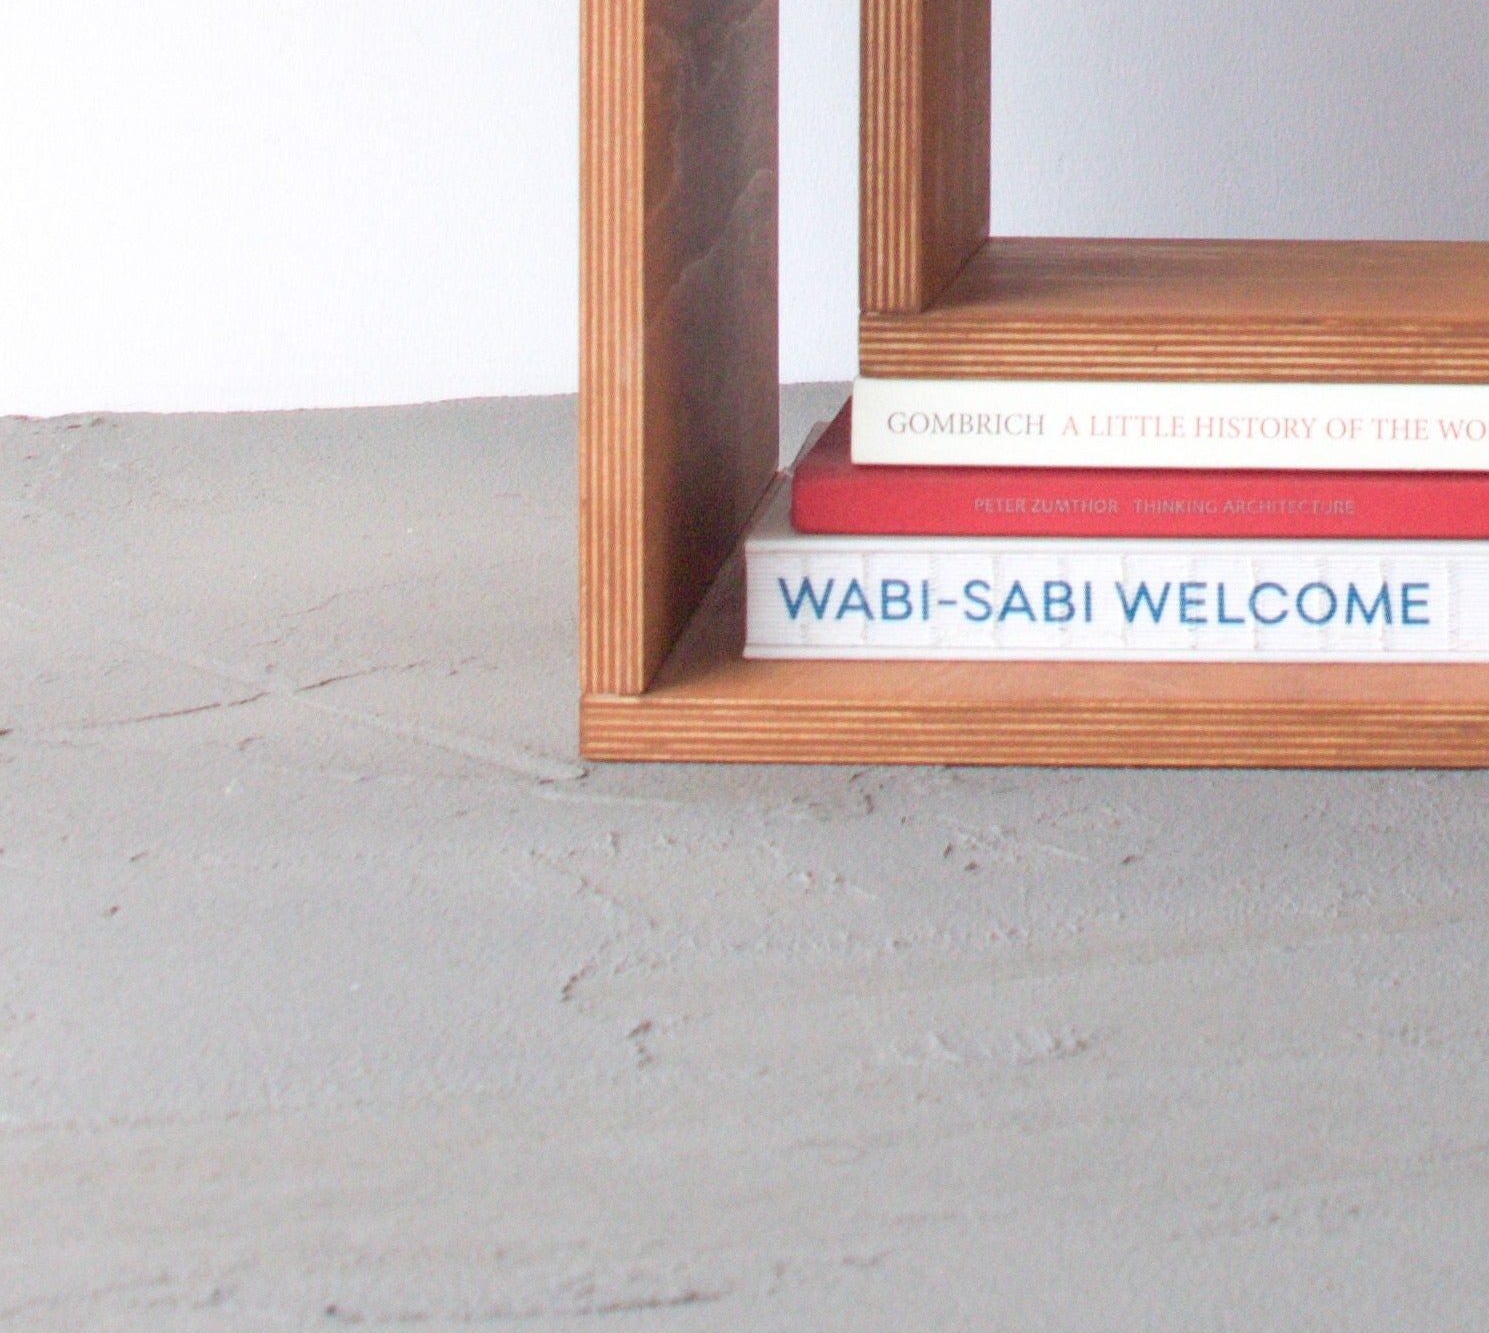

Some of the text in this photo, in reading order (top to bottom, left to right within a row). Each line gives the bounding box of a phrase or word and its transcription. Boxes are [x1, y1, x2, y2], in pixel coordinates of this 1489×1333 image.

[886, 411, 1044, 435] GOMBRICH
[1061, 414, 1079, 436] A
[1089, 414, 1184, 437] LITTLE
[1195, 415, 1316, 439] HISTORY
[1325, 417, 1364, 439] OF
[1370, 418, 1428, 440] THE
[973, 497, 1026, 514] PETER
[1030, 497, 1119, 514] ZUMTHOR
[1132, 498, 1217, 515] THINKING
[776, 576, 1431, 625] WABI-SABI WELCOME
